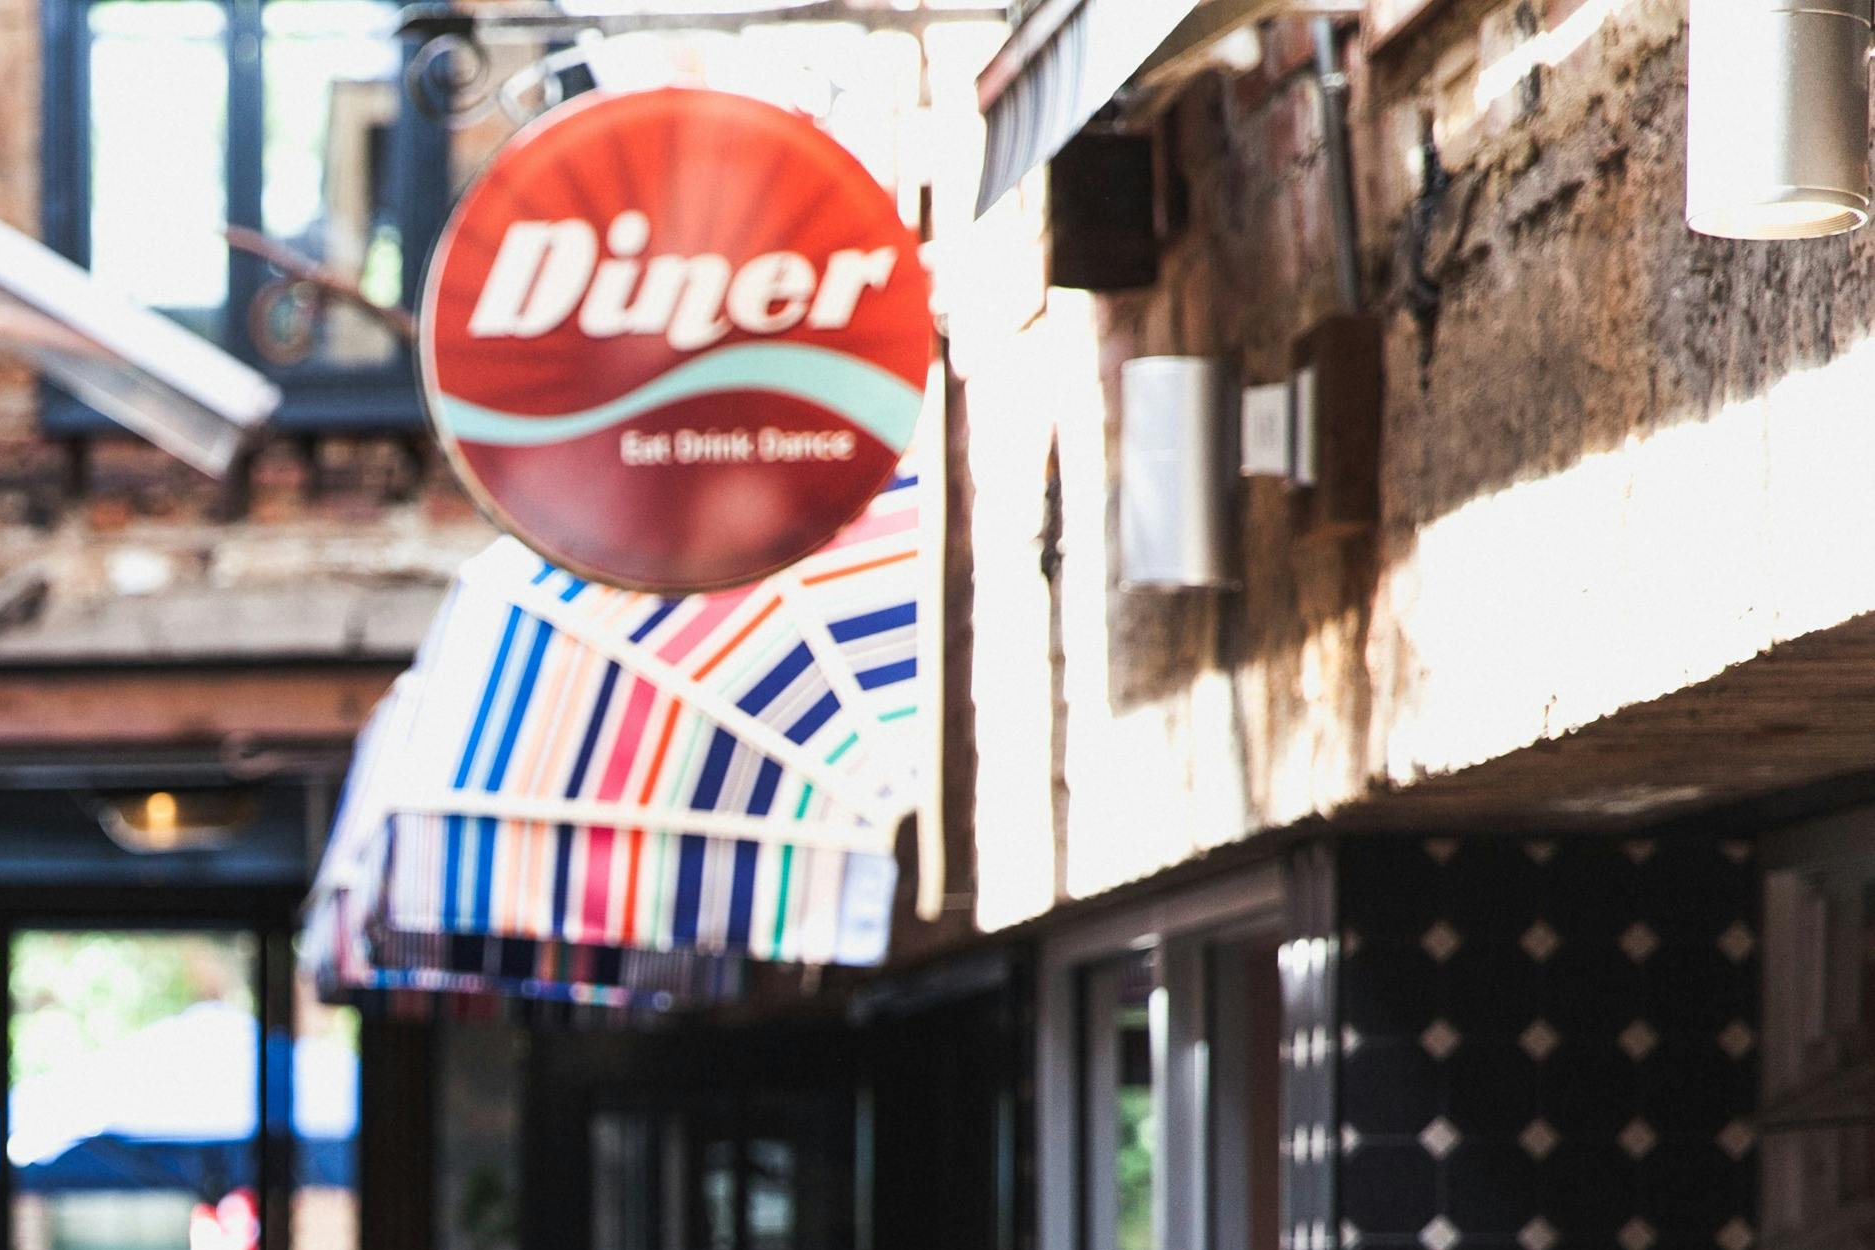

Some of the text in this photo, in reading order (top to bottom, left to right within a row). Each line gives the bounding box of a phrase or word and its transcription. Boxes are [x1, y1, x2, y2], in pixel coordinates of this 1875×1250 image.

[467, 210, 898, 352] Diner
[620, 426, 857, 465] Eat Drink Dance
